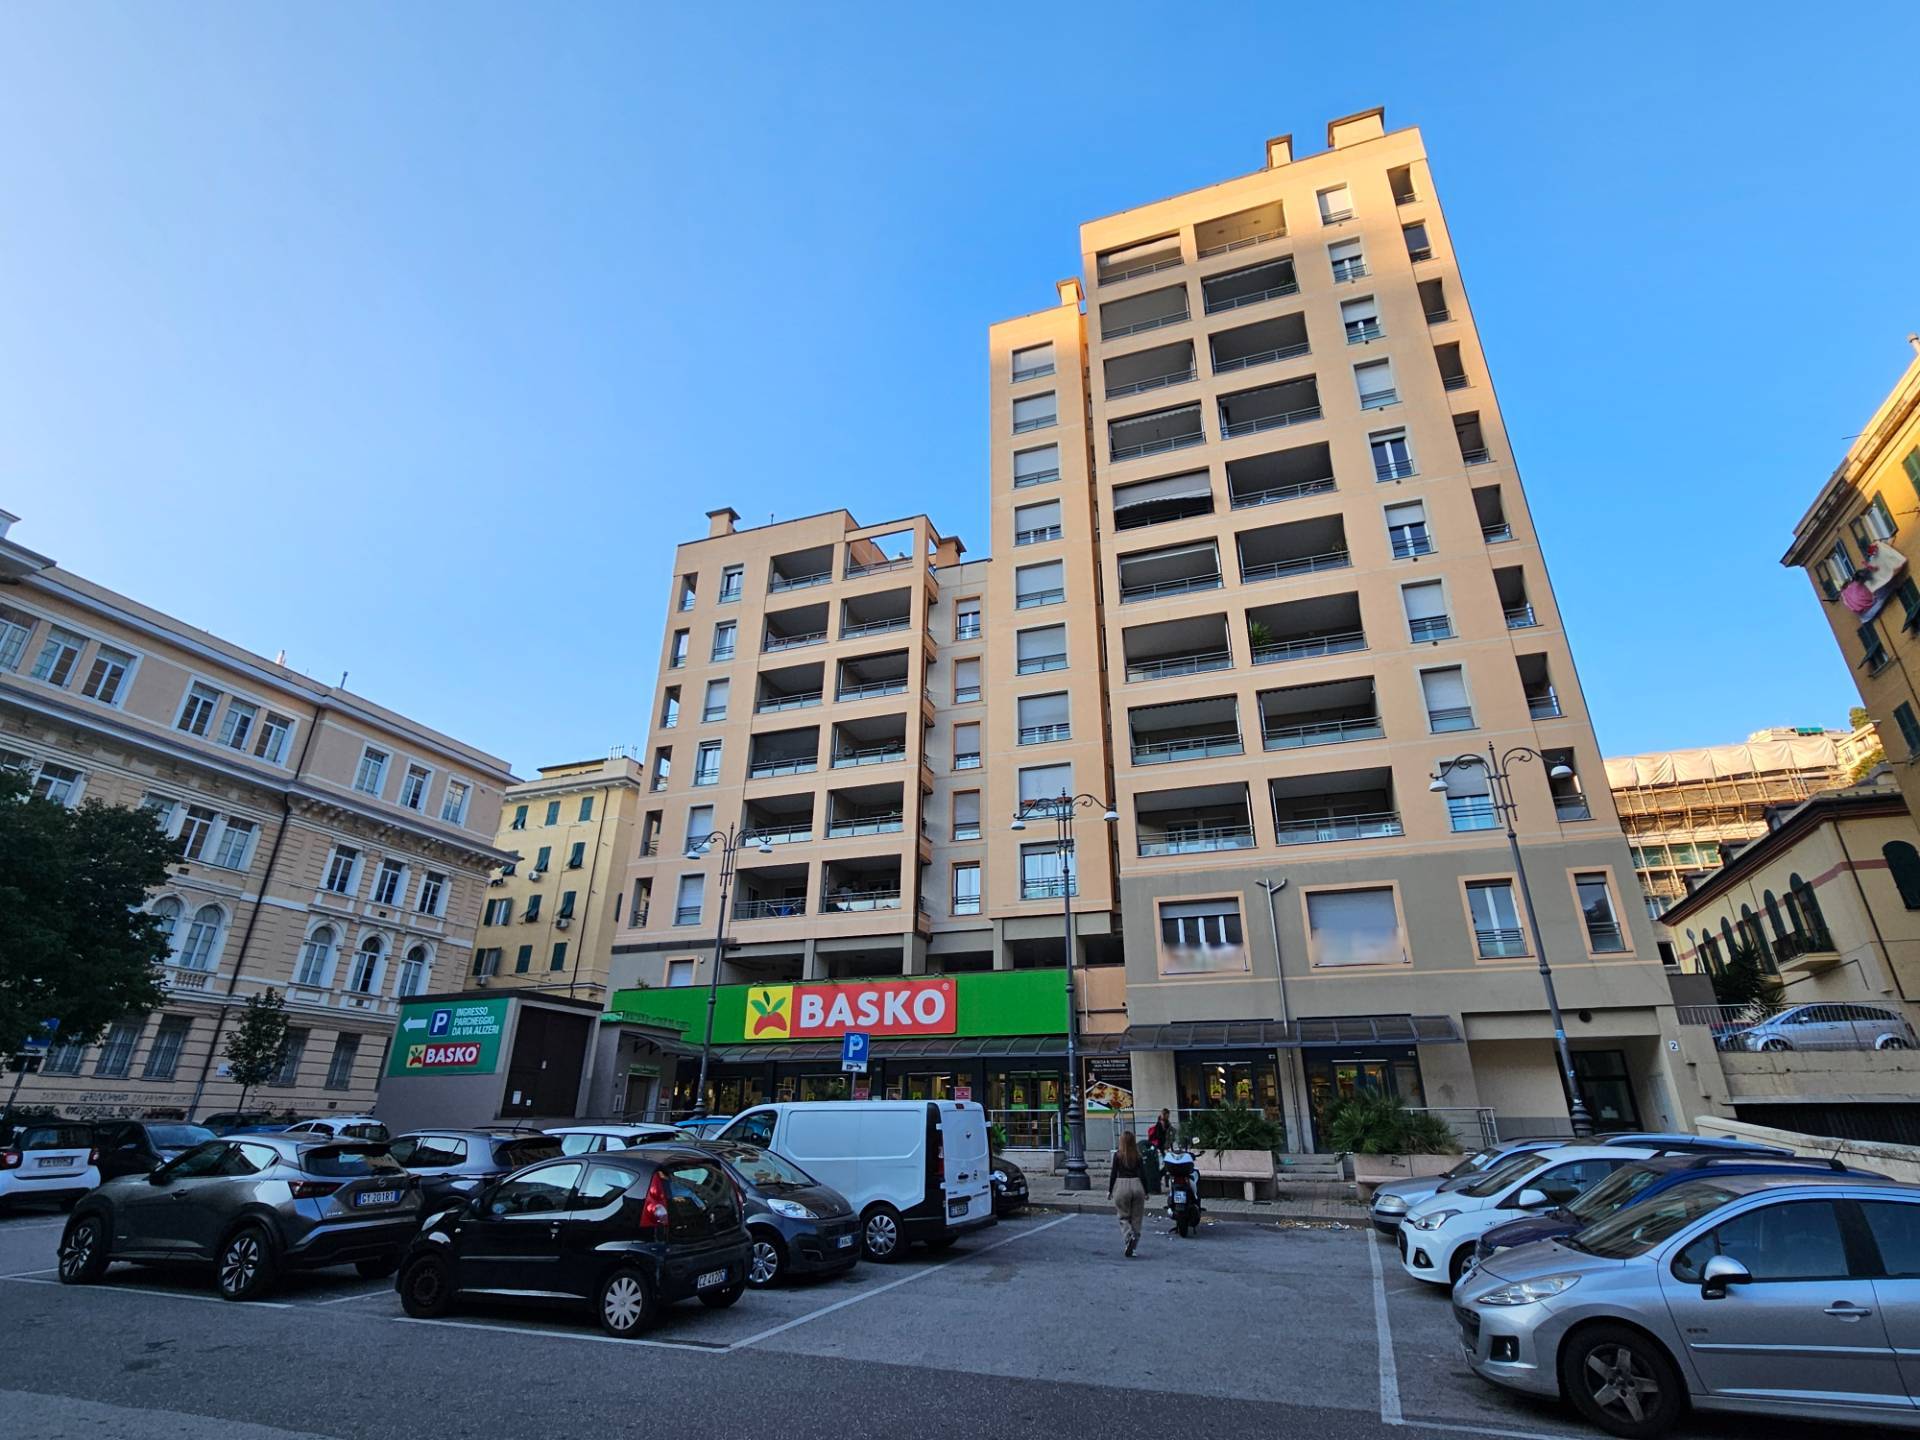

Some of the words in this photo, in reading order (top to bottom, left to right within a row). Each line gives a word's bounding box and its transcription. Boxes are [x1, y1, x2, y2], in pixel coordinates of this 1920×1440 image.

[456, 1007, 488, 1016] INGRESSO
[800, 989, 945, 1028] BASKO
[433, 1013, 448, 1033] P
[453, 1016, 495, 1026] PARCHEGGIO
[451, 1026, 461, 1036] DA
[462, 1026, 473, 1035] VIA
[474, 1025, 500, 1035] ALIZERI
[425, 1046, 478, 1064] BASKO
[848, 1034, 864, 1058] P
